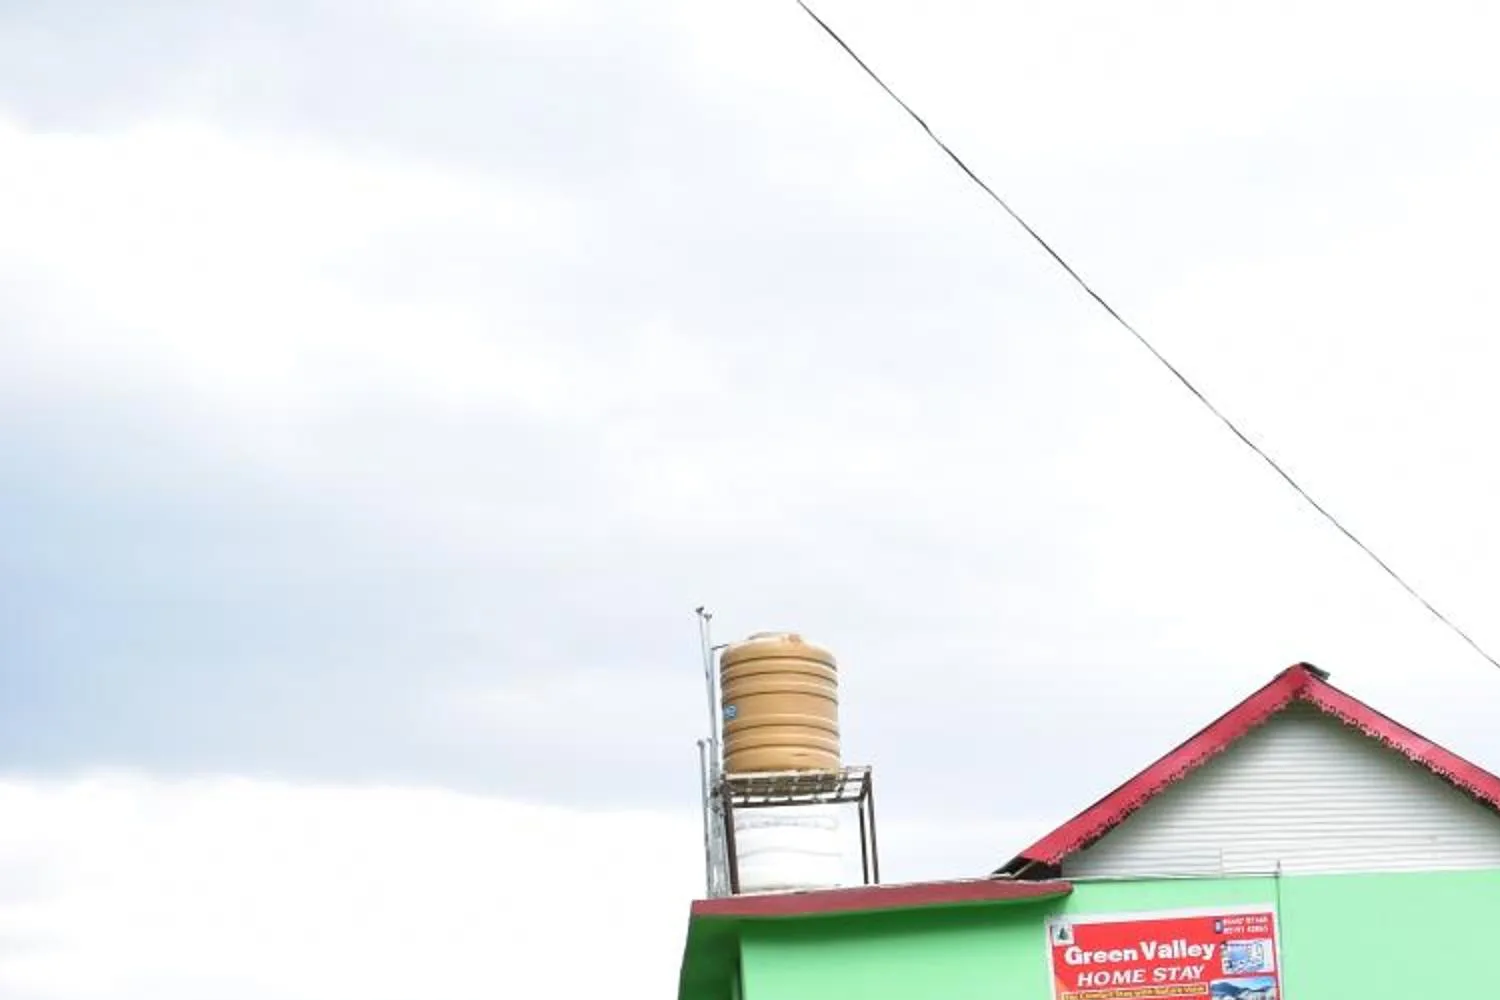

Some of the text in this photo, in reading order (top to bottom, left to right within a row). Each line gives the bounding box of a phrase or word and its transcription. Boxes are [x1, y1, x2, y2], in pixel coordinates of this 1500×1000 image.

[1064, 939, 1215, 966] Green Valley
[1077, 965, 1205, 986] HOME STAY
